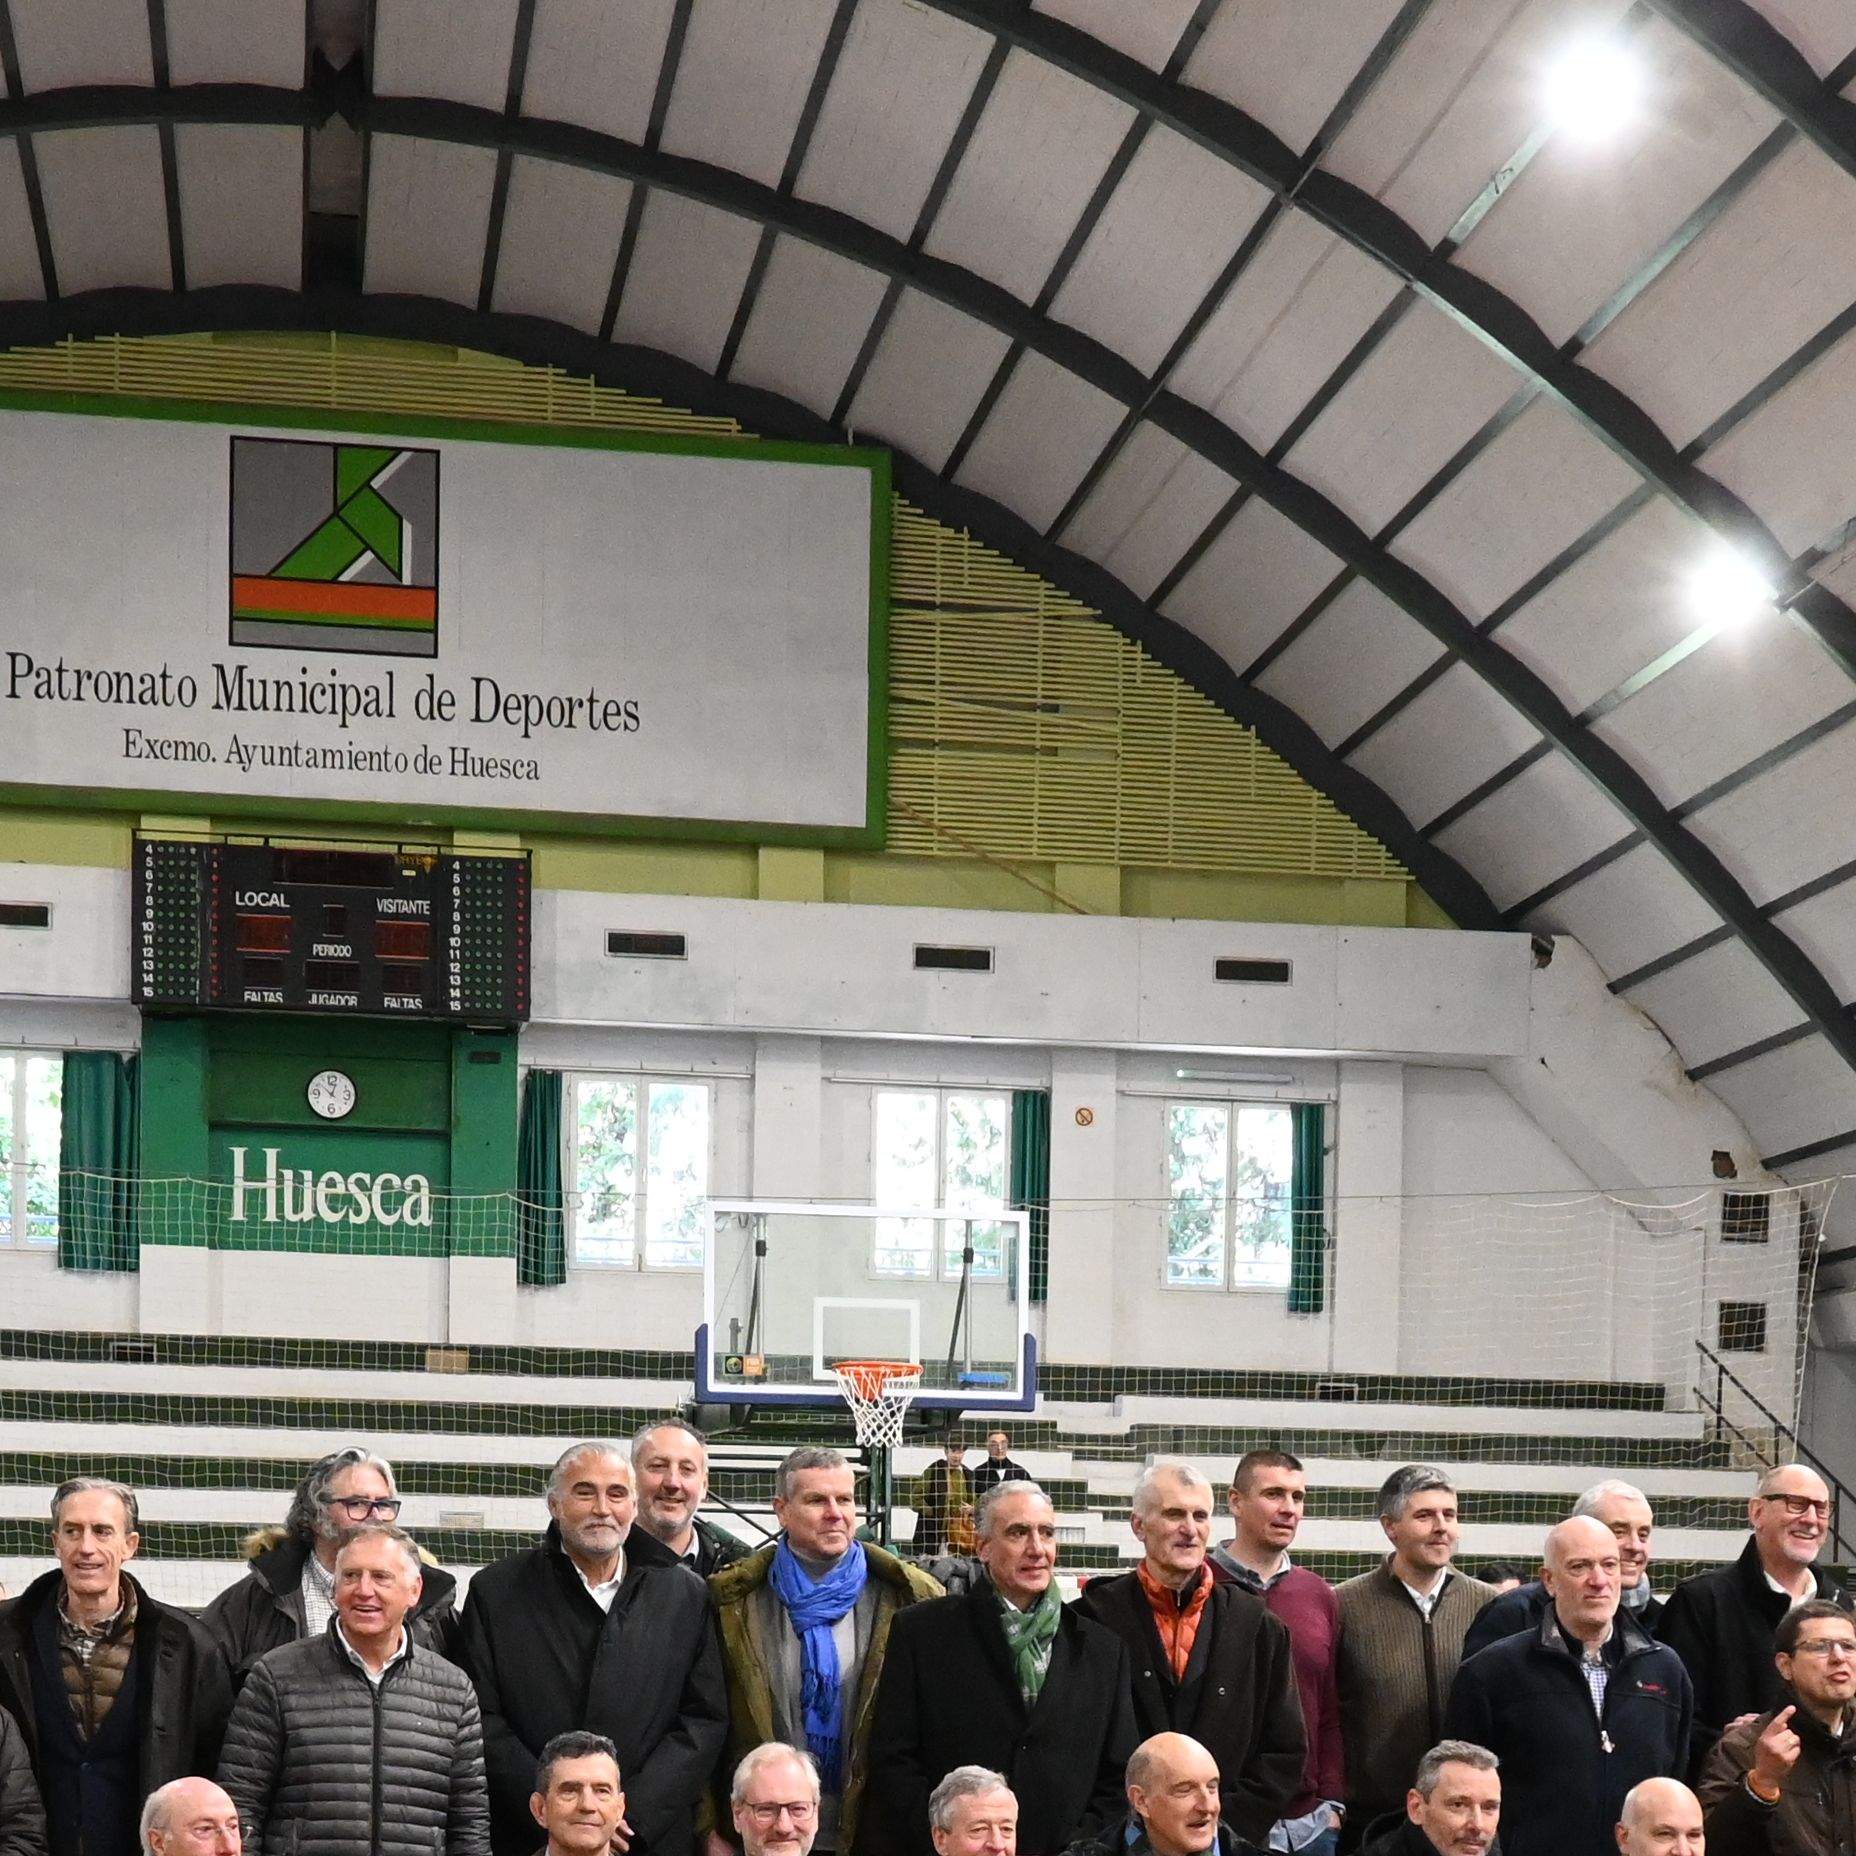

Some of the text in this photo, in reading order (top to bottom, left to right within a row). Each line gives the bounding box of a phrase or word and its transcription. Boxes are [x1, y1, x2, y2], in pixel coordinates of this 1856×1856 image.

[5, 651, 641, 739] Patronato Municipal de Deportes
[122, 728, 540, 780] Excmo. Ayuntamiento de Huesca
[145, 844, 154, 854] 4
[145, 857, 154, 867] 5
[452, 861, 461, 871] 4
[452, 873, 461, 884] 5
[145, 883, 154, 893] 7
[235, 891, 290, 908] LOCAL
[452, 899, 461, 909] 7
[376, 897, 431, 915] VISITANTE
[142, 921, 154, 932] 10
[143, 935, 153, 945] 11
[449, 937, 461, 947] 10
[142, 948, 154, 958] 12
[312, 943, 352, 957] PERIODO
[449, 949, 461, 960] 11
[142, 960, 154, 971] 13
[449, 962, 461, 973] 12
[449, 975, 461, 986] 13
[227, 1146, 434, 1227] Huesca
